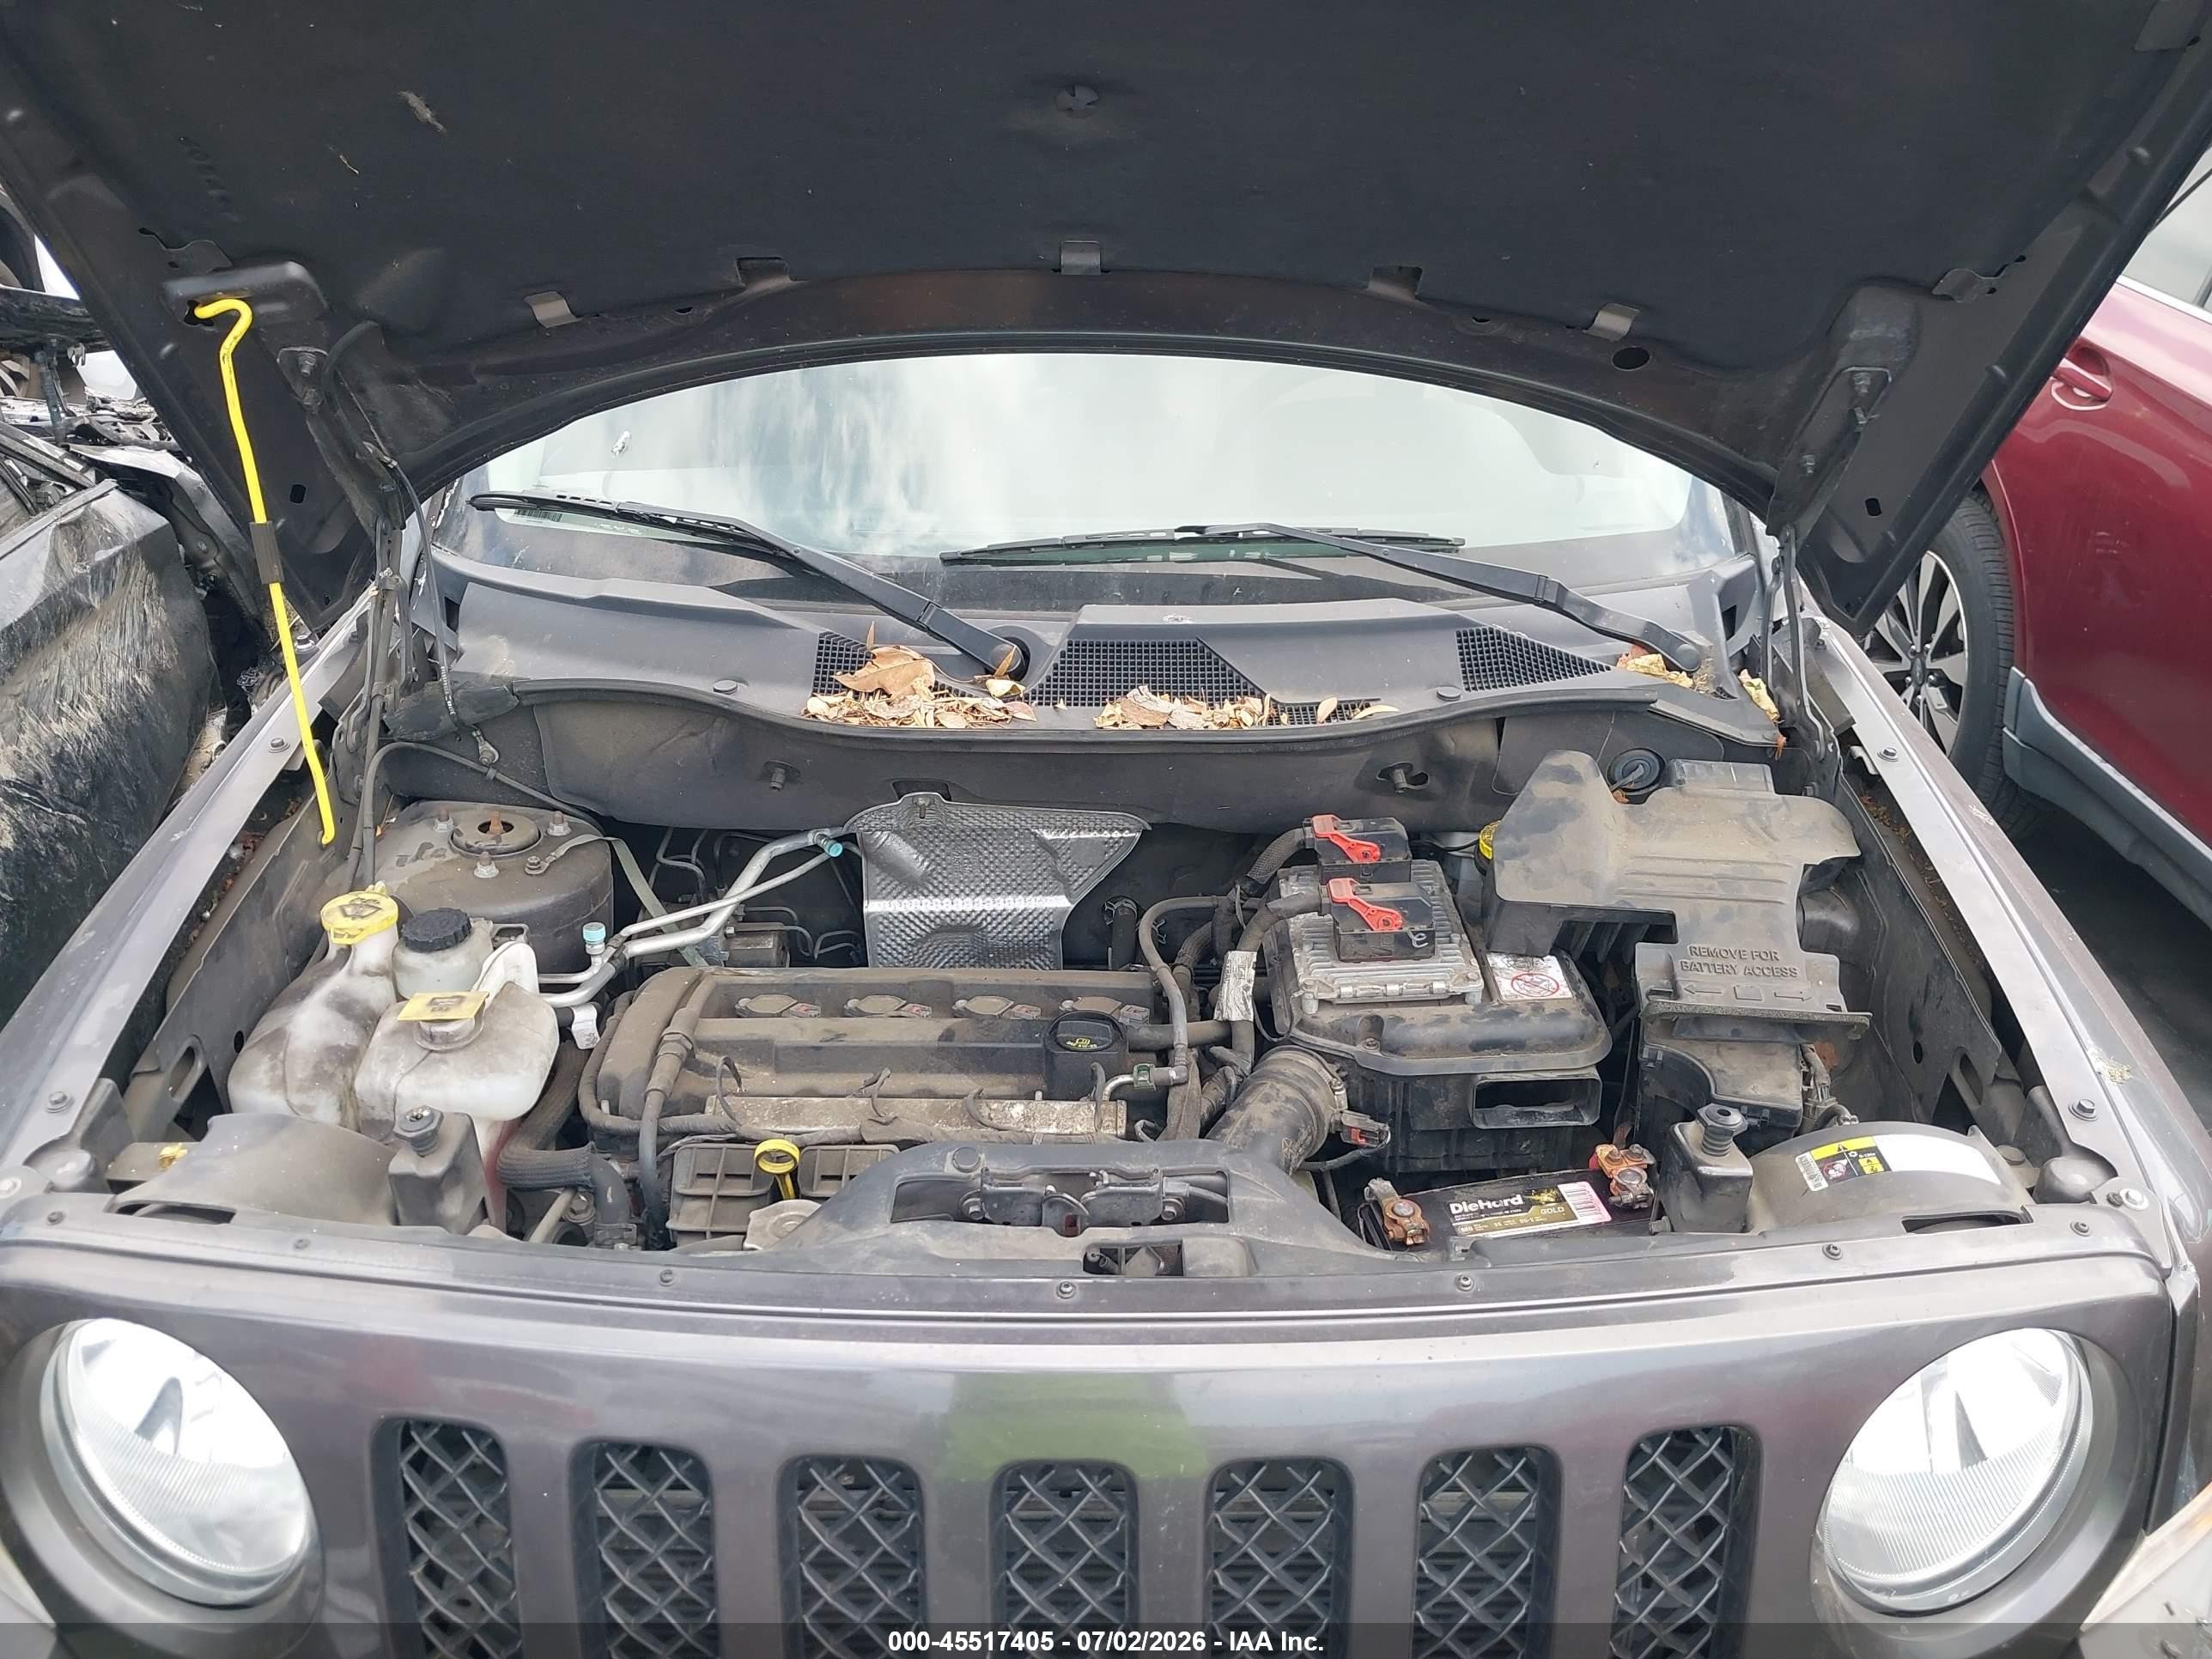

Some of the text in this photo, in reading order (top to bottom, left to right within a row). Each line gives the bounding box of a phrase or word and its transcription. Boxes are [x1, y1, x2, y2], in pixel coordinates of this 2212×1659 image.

[1687, 945, 1780, 962] REMOVE FOR
[1679, 959, 1799, 978] BATTERY ACCESS
[1449, 1194, 1524, 1215] DieHard
[1540, 1206, 1565, 1215] GOLD
